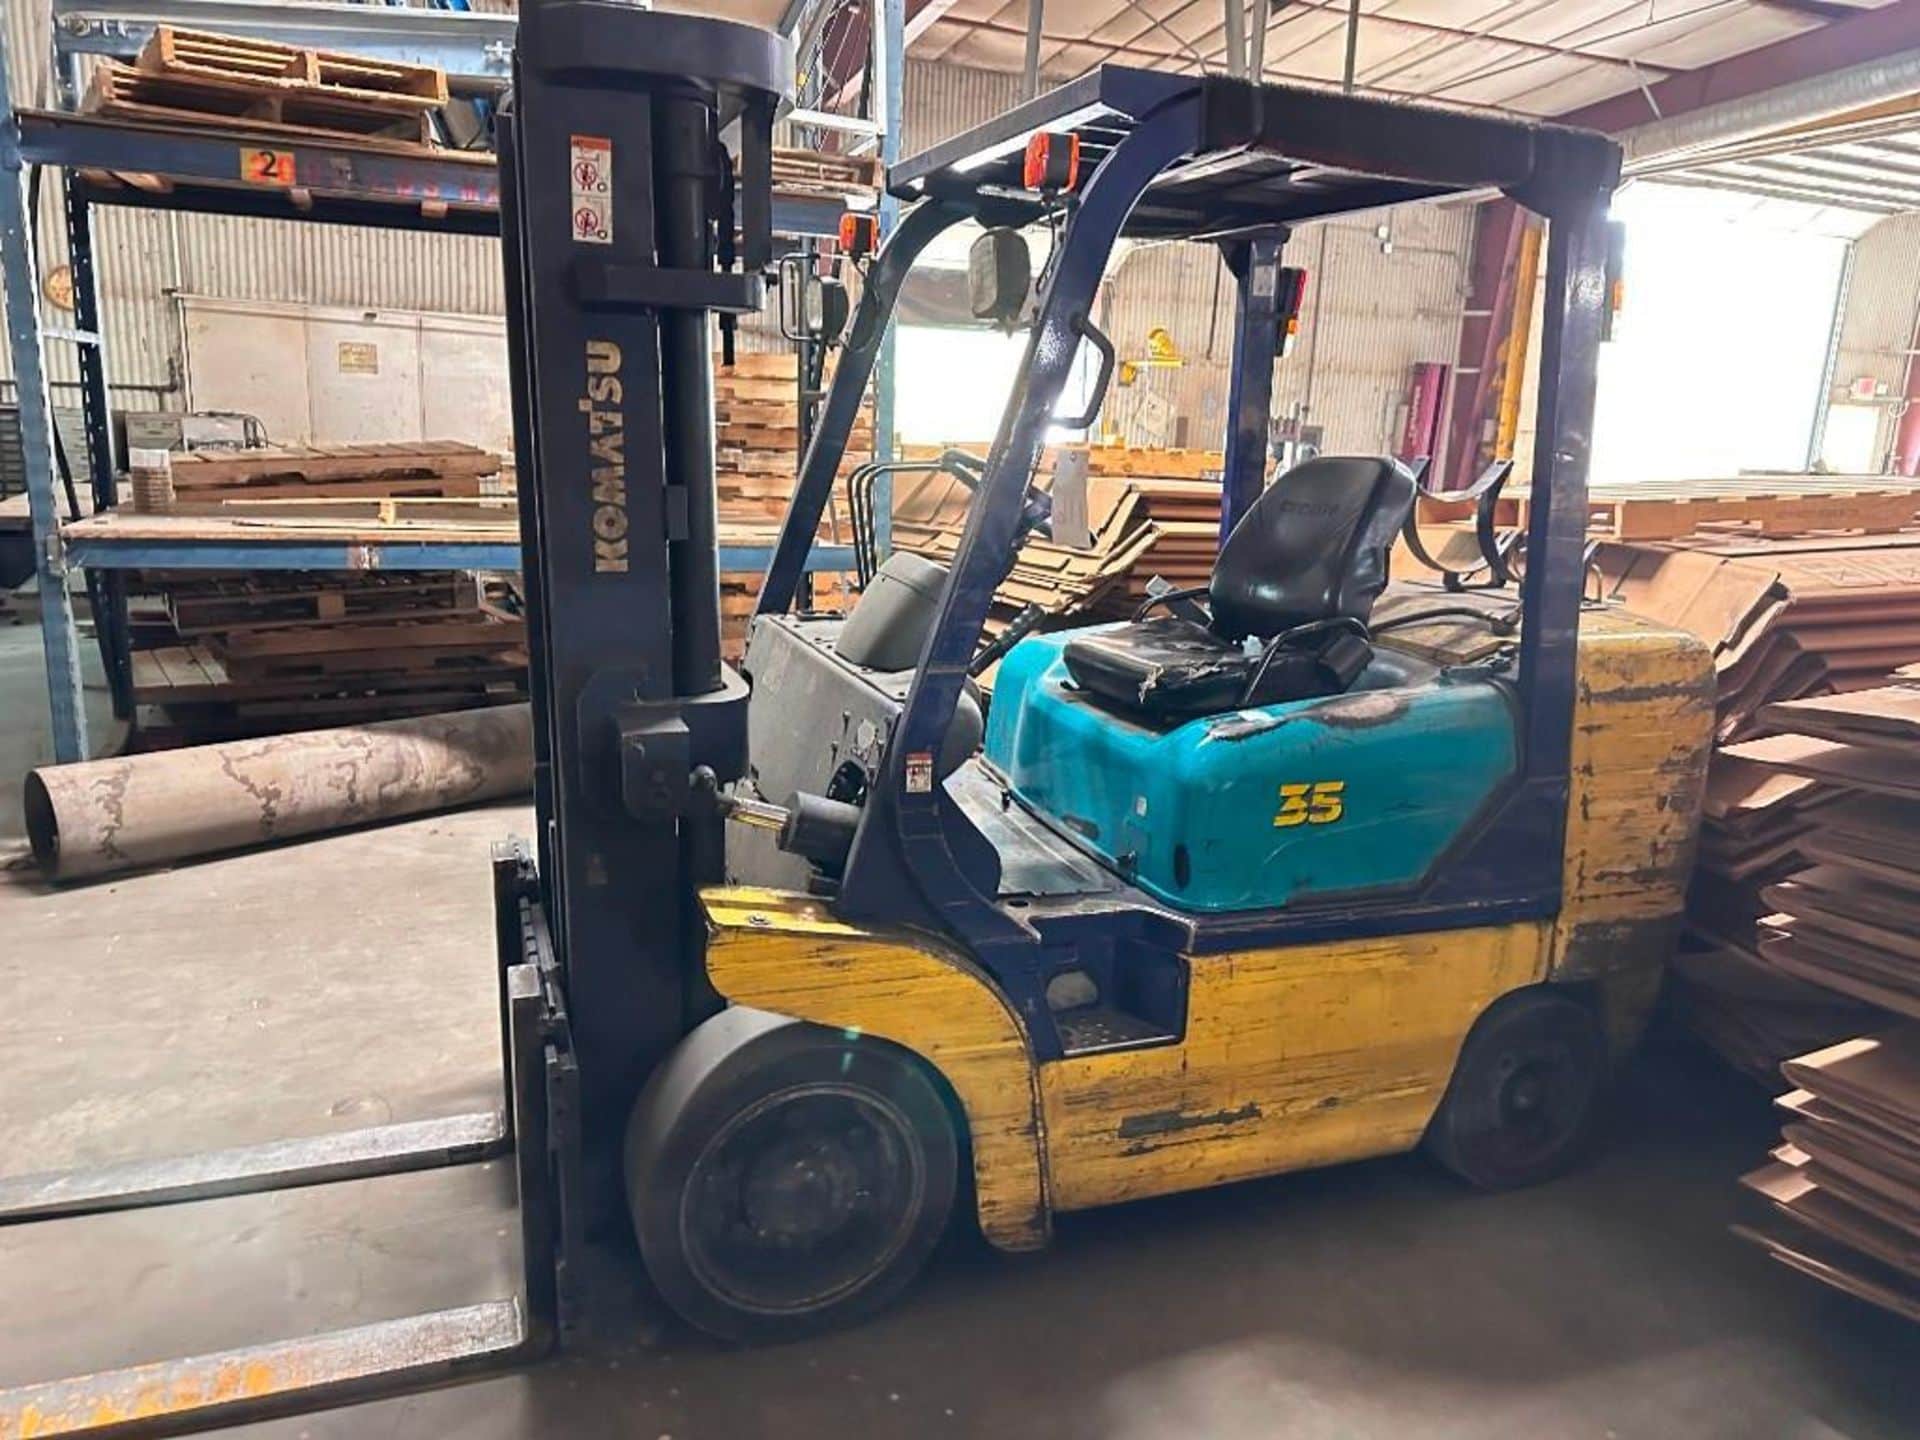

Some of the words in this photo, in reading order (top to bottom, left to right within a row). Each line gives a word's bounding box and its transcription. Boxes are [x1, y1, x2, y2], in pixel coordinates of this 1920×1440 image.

[259, 151, 277, 177] 2
[579, 340, 628, 573] KOMATSU
[1273, 781, 1344, 827] 35
